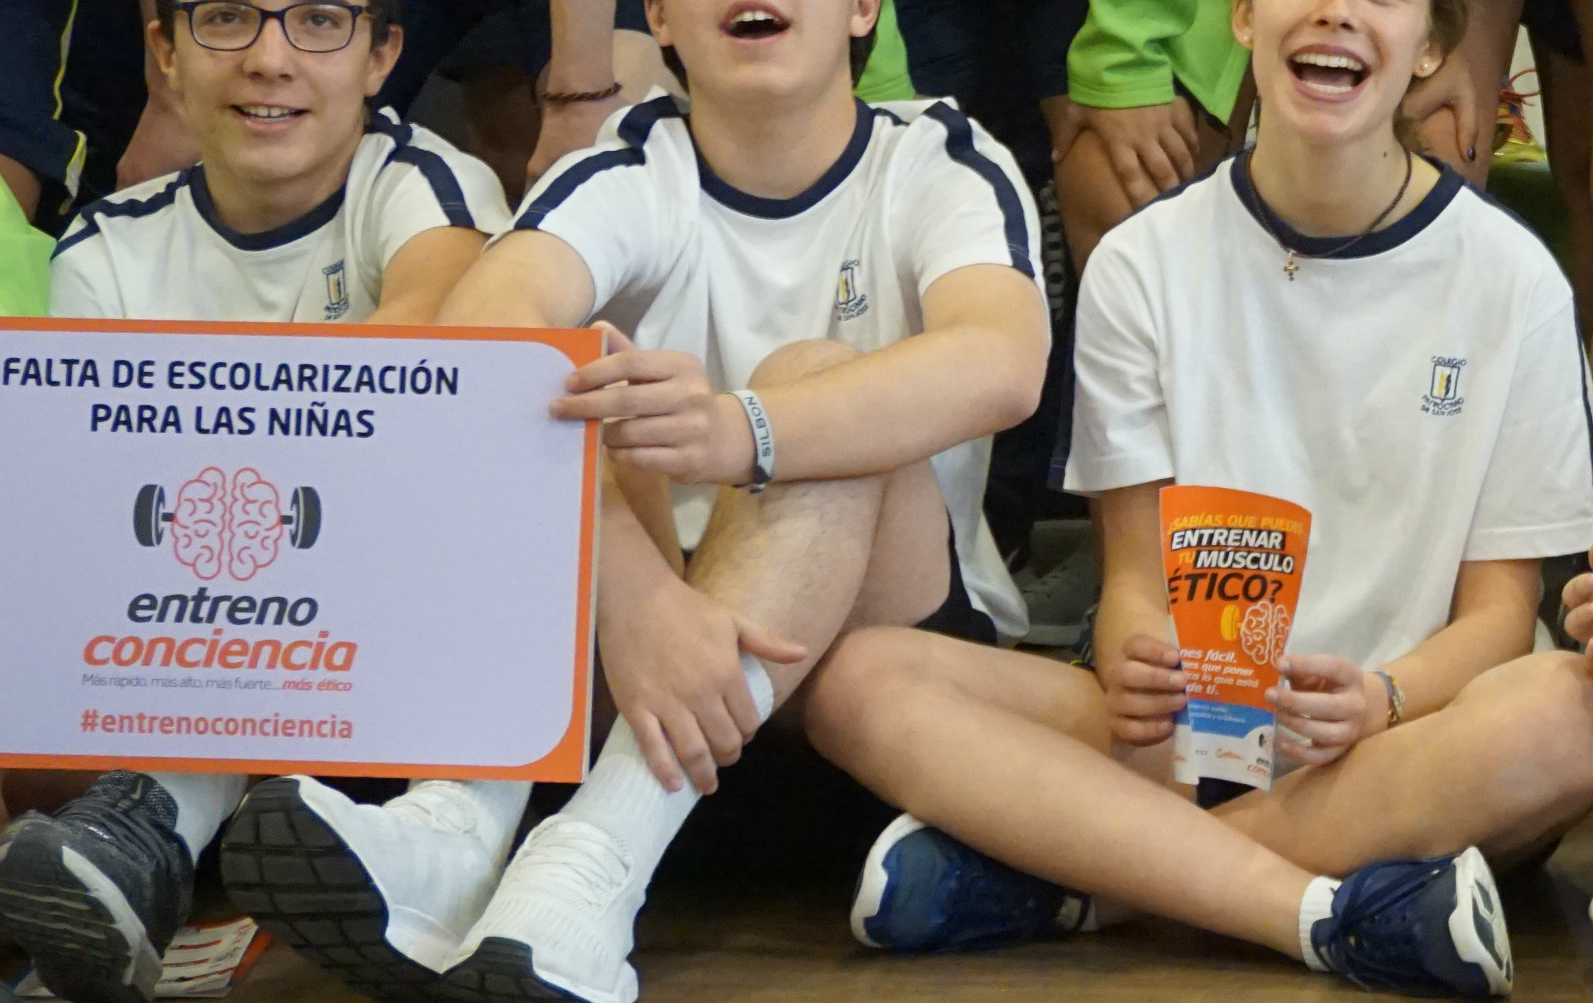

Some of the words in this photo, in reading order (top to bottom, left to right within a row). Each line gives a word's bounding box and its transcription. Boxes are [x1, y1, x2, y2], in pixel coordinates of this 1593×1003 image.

[2, 357, 100, 387] FALTA
[112, 359, 156, 389] DE
[167, 359, 459, 395] ESCOLARIZACIÓN
[90, 403, 183, 434] PARA
[194, 406, 256, 436] LAS
[268, 401, 375, 438] NIÑAS
[745, 396, 772, 457] SILBON
[1171, 529, 1283, 550] ENTRENAR
[1227, 515, 1257, 528] QUE
[1178, 551, 1196, 565] TU
[1196, 547, 1294, 574] MÚSCULO
[1168, 567, 1283, 605] ÉTICO?
[127, 587, 319, 627] entreno
[83, 628, 358, 672] conciencia
[81, 708, 354, 739] #entrenoconciencia
